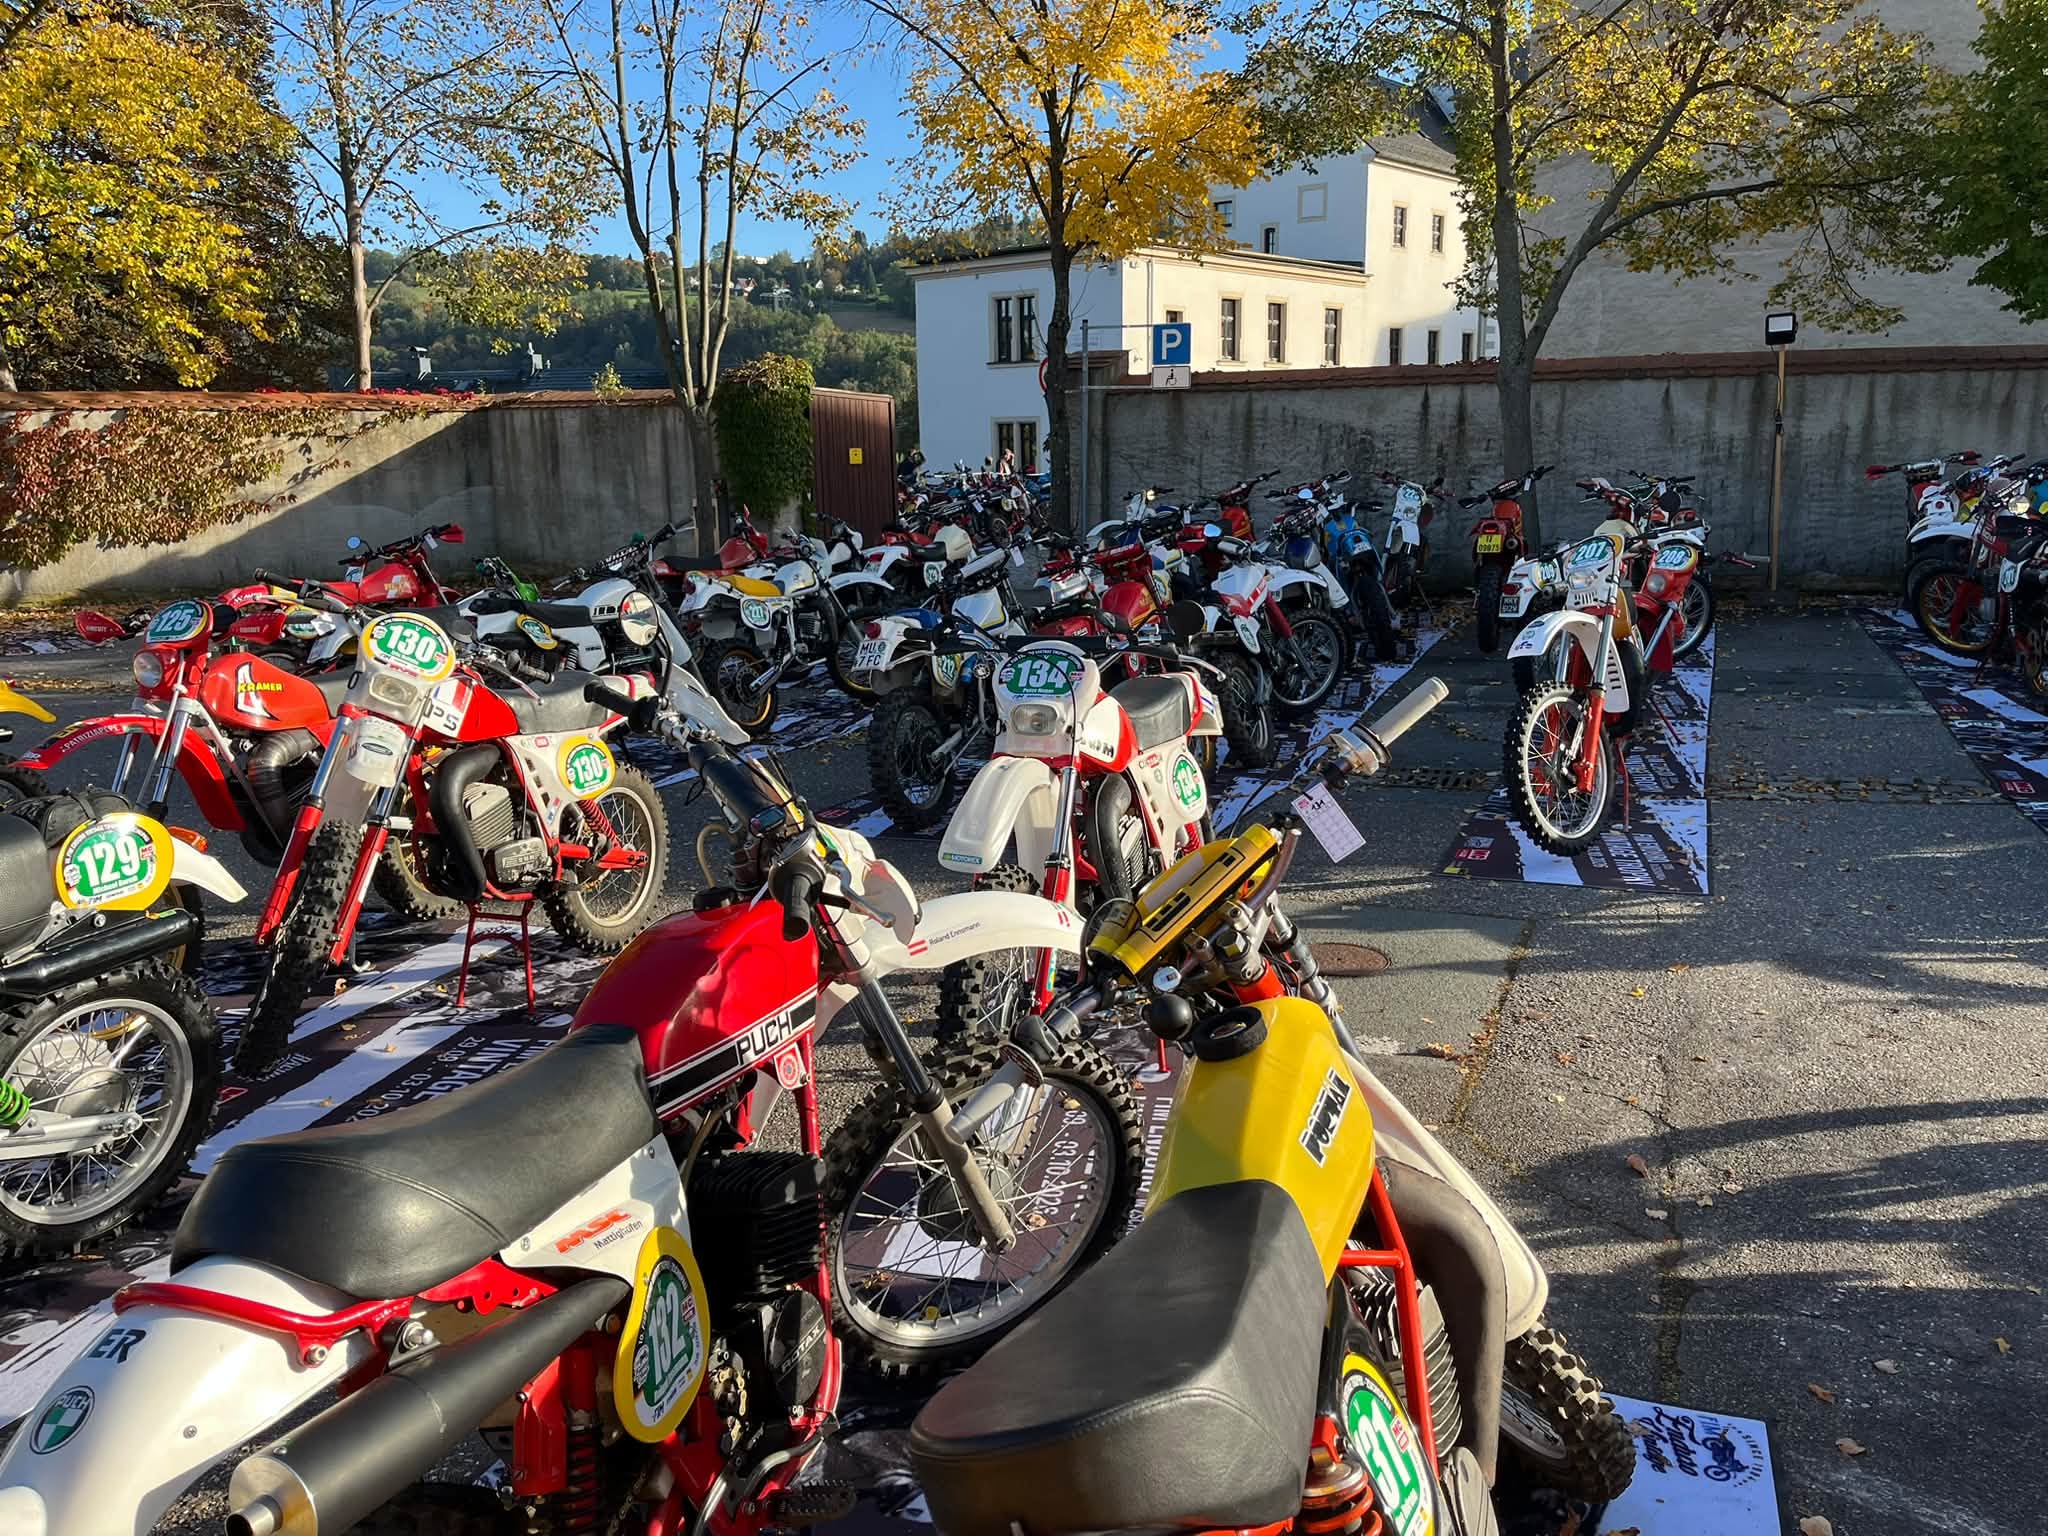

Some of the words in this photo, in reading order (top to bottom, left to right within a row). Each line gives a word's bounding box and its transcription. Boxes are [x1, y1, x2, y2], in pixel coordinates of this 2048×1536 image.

[1161, 328, 1182, 360] P
[1576, 542, 1606, 559] 207
[155, 609, 194, 632] 125
[387, 625, 437, 663] 130
[237, 682, 283, 692] KRAMER
[1017, 660, 1069, 689] 134
[572, 752, 604, 784] 130
[77, 835, 141, 888] 129
[1614, 858, 1656, 887] TROPHY
[929, 932, 950, 946] Roland
[735, 1010, 792, 1066] PUCH
[593, 1220, 644, 1250] Mattighofen
[648, 1281, 687, 1387] 132
[782, 1326, 820, 1374] ROTAX
[55, 1394, 89, 1409] PUCH
[1697, 1415, 1721, 1436] FIM
